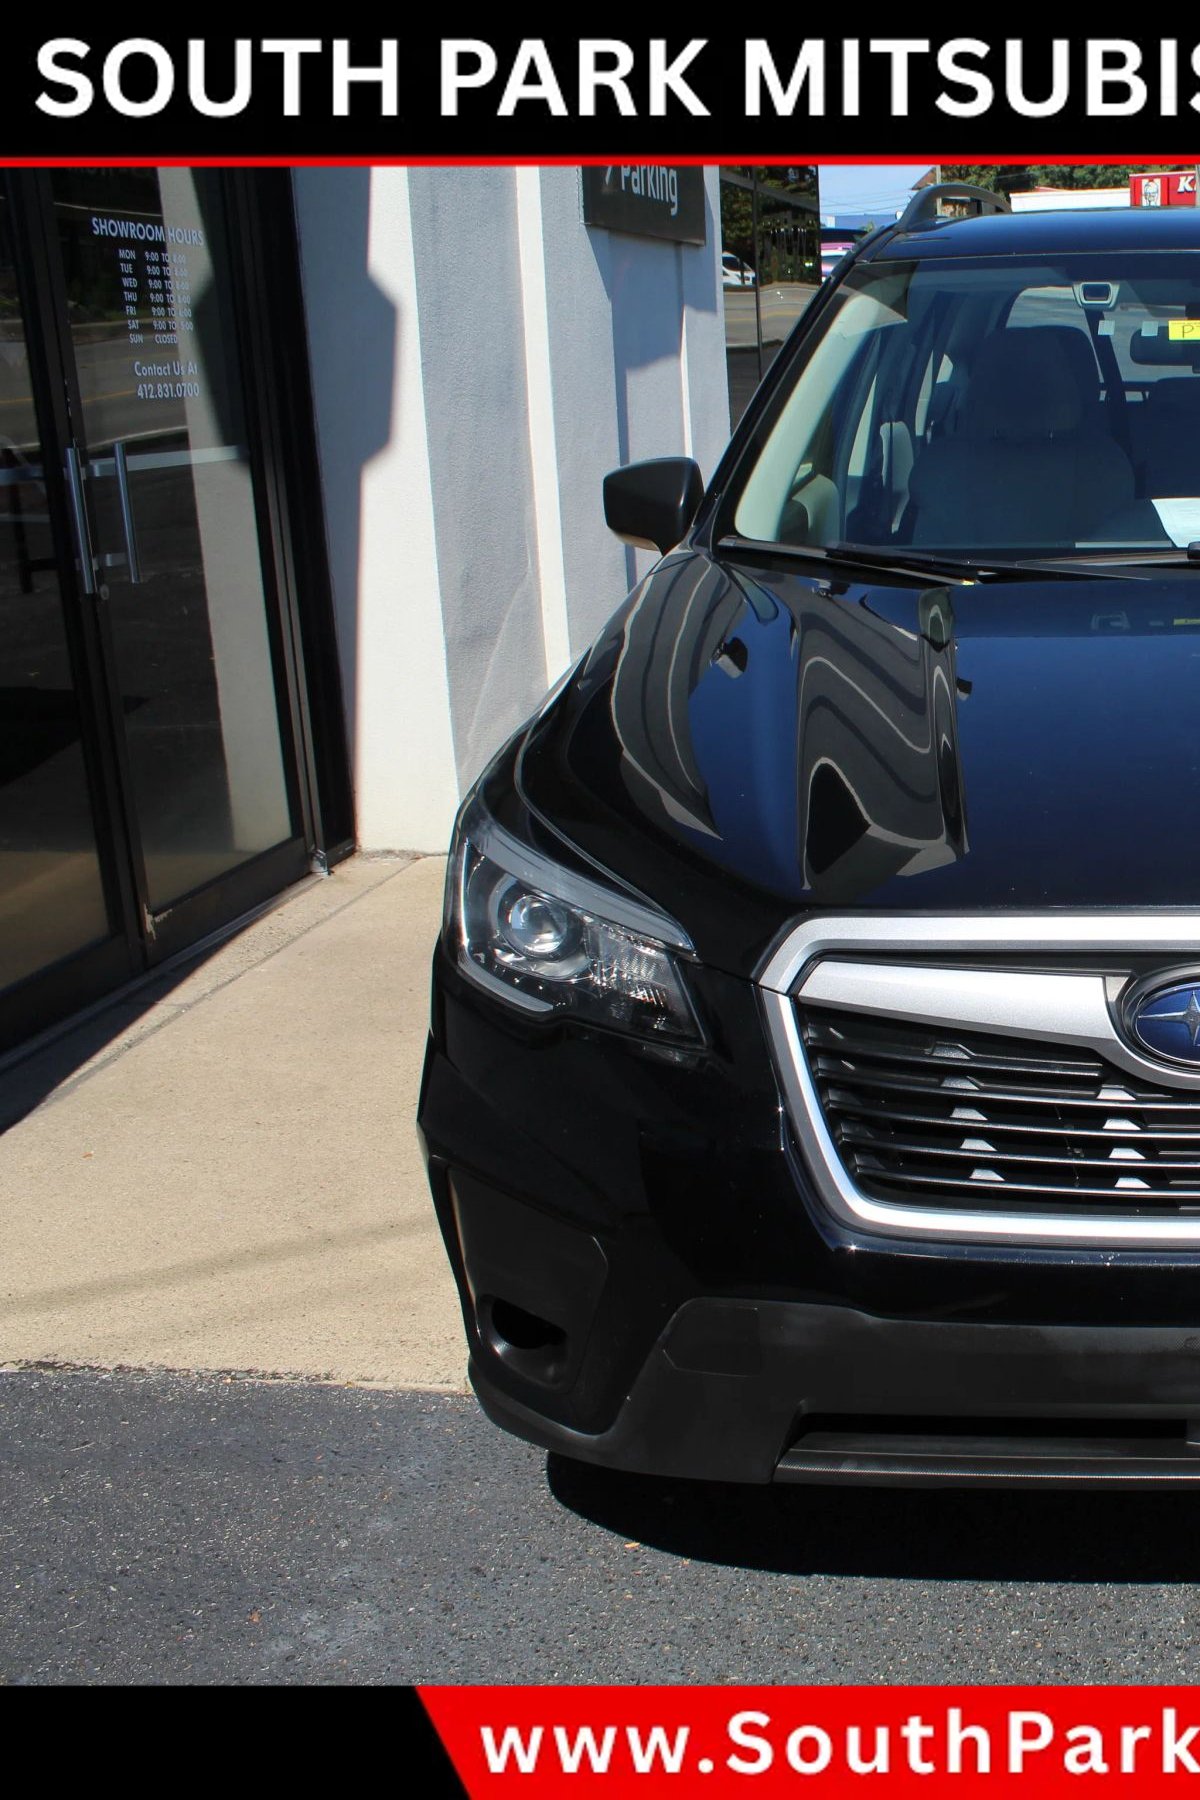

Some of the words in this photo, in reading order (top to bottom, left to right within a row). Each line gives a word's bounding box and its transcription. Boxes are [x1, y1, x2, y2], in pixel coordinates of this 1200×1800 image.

[92, 217, 166, 242] SHOWROOM
[167, 226, 204, 246] HOURS
[119, 249, 136, 260] MON
[145, 251, 159, 262] 9:00
[162, 252, 170, 263] TO
[120, 263, 133, 274] TUE
[147, 265, 160, 276] 9:00
[163, 266, 172, 276] TO
[122, 278, 138, 288] WED
[148, 279, 162, 290] 9:00
[165, 280, 174, 290] TO
[124, 292, 137, 302] THU
[150, 293, 164, 304] 9:00
[166, 294, 175, 304] TO
[126, 305, 137, 315] FRI
[151, 307, 165, 317] 9:00
[168, 307, 176, 317] TO
[127, 320, 139, 330] SAT
[153, 320, 167, 331] 9:00
[169, 321, 177, 331] TO
[129, 334, 143, 344] SUN
[155, 334, 178, 344] CLOSED
[134, 361, 171, 377] Contact
[173, 362, 184, 376] Us
[187, 362, 198, 376] At
[137, 383, 200, 399] 412.831.0700
